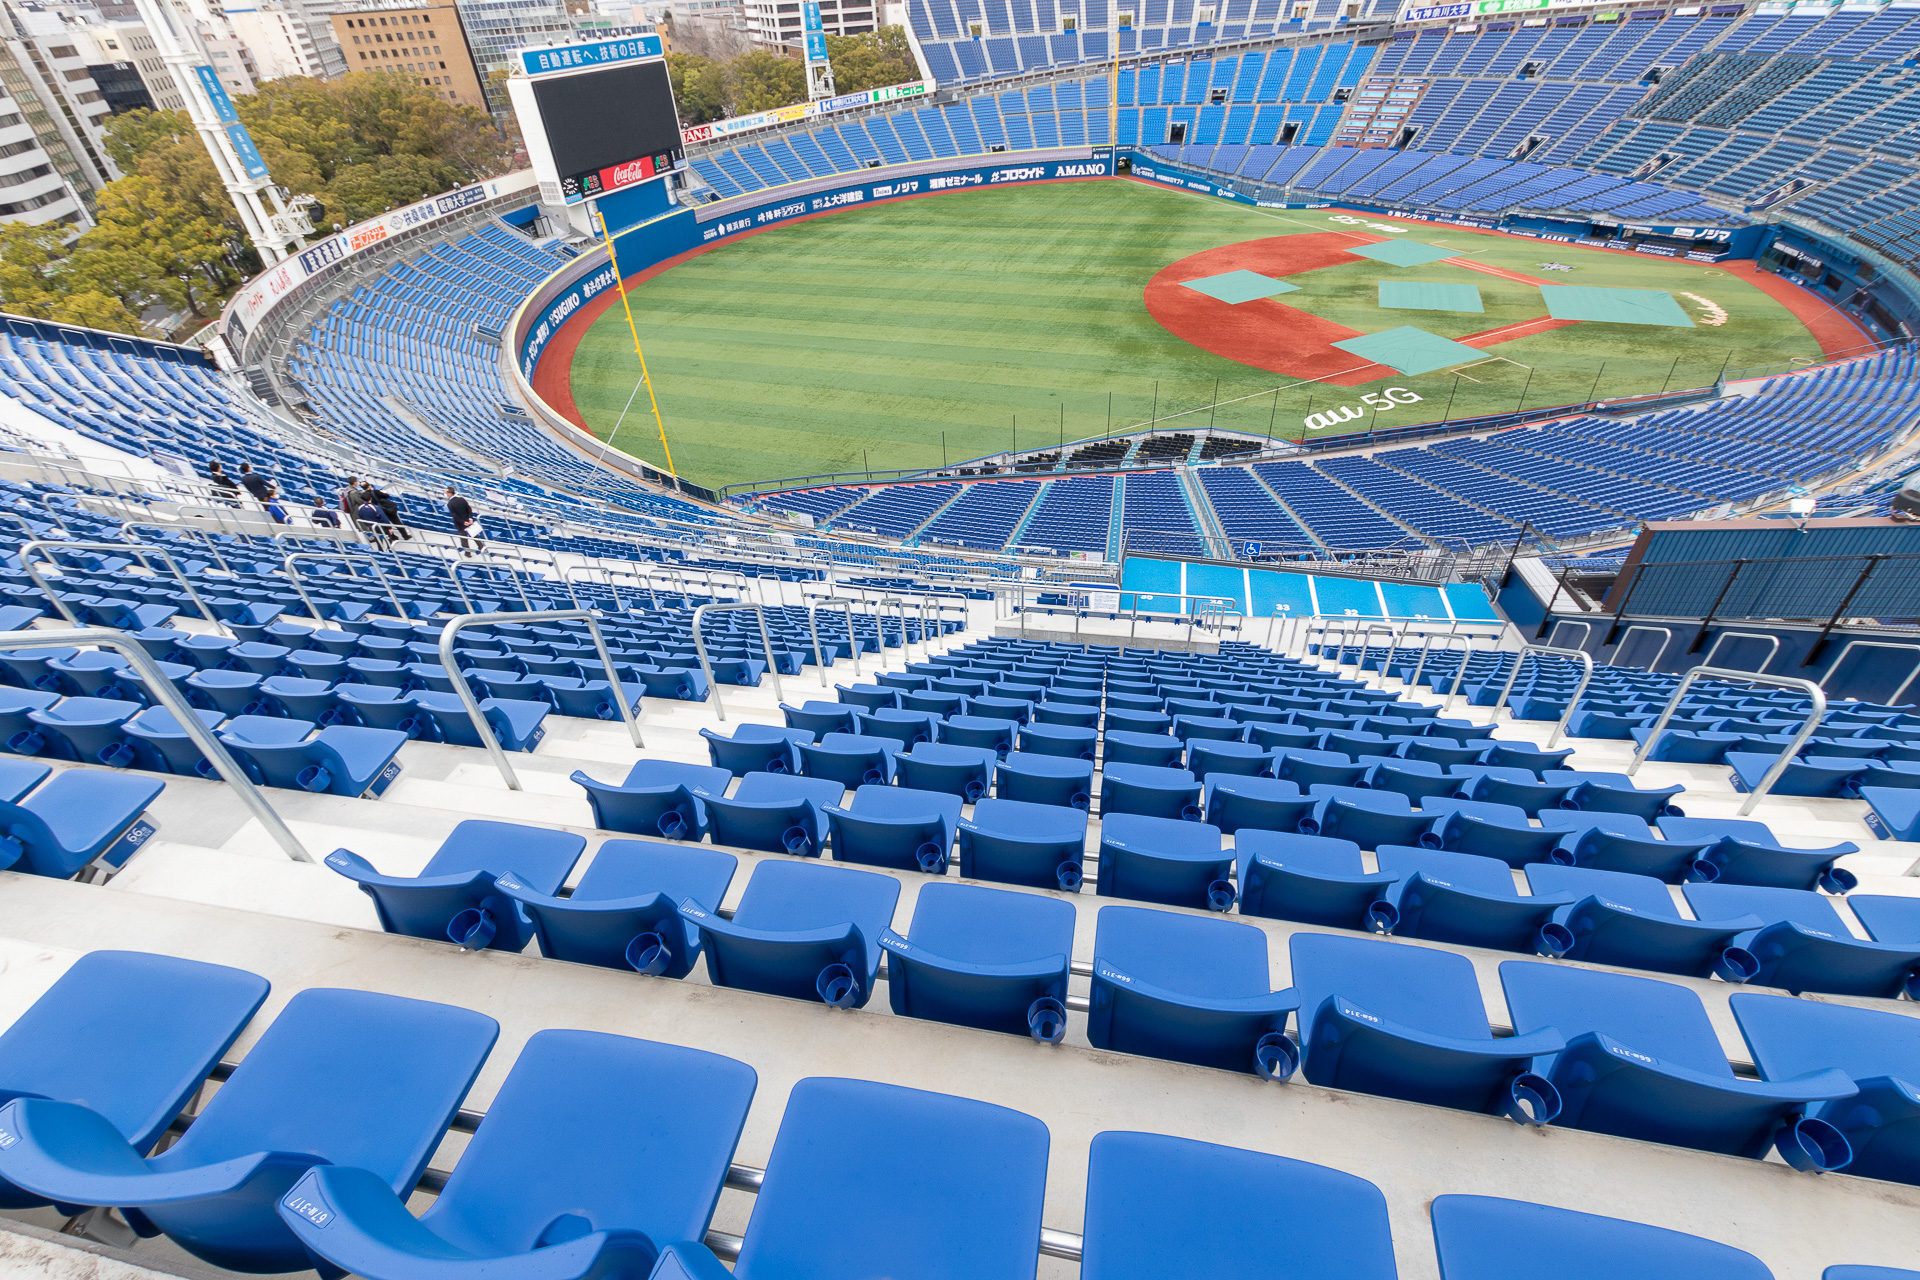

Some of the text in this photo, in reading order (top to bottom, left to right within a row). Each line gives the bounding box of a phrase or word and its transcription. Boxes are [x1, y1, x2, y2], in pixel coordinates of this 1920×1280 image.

[539, 41, 651, 69] 自動運転へ、技術の日産。
[999, 166, 1045, 182] コロワイド
[1055, 163, 1106, 177] AMANO
[893, 181, 919, 195] ノジマ
[929, 173, 983, 189] 湘南ゼミナール
[438, 194, 467, 214] 昭和大学
[831, 190, 864, 206] 大洋建設
[1695, 228, 1732, 241] ノジマ
[553, 292, 580, 324] SUGIKO
[1304, 387, 1424, 430] au 5G
[1276, 603, 1290, 611] 33
